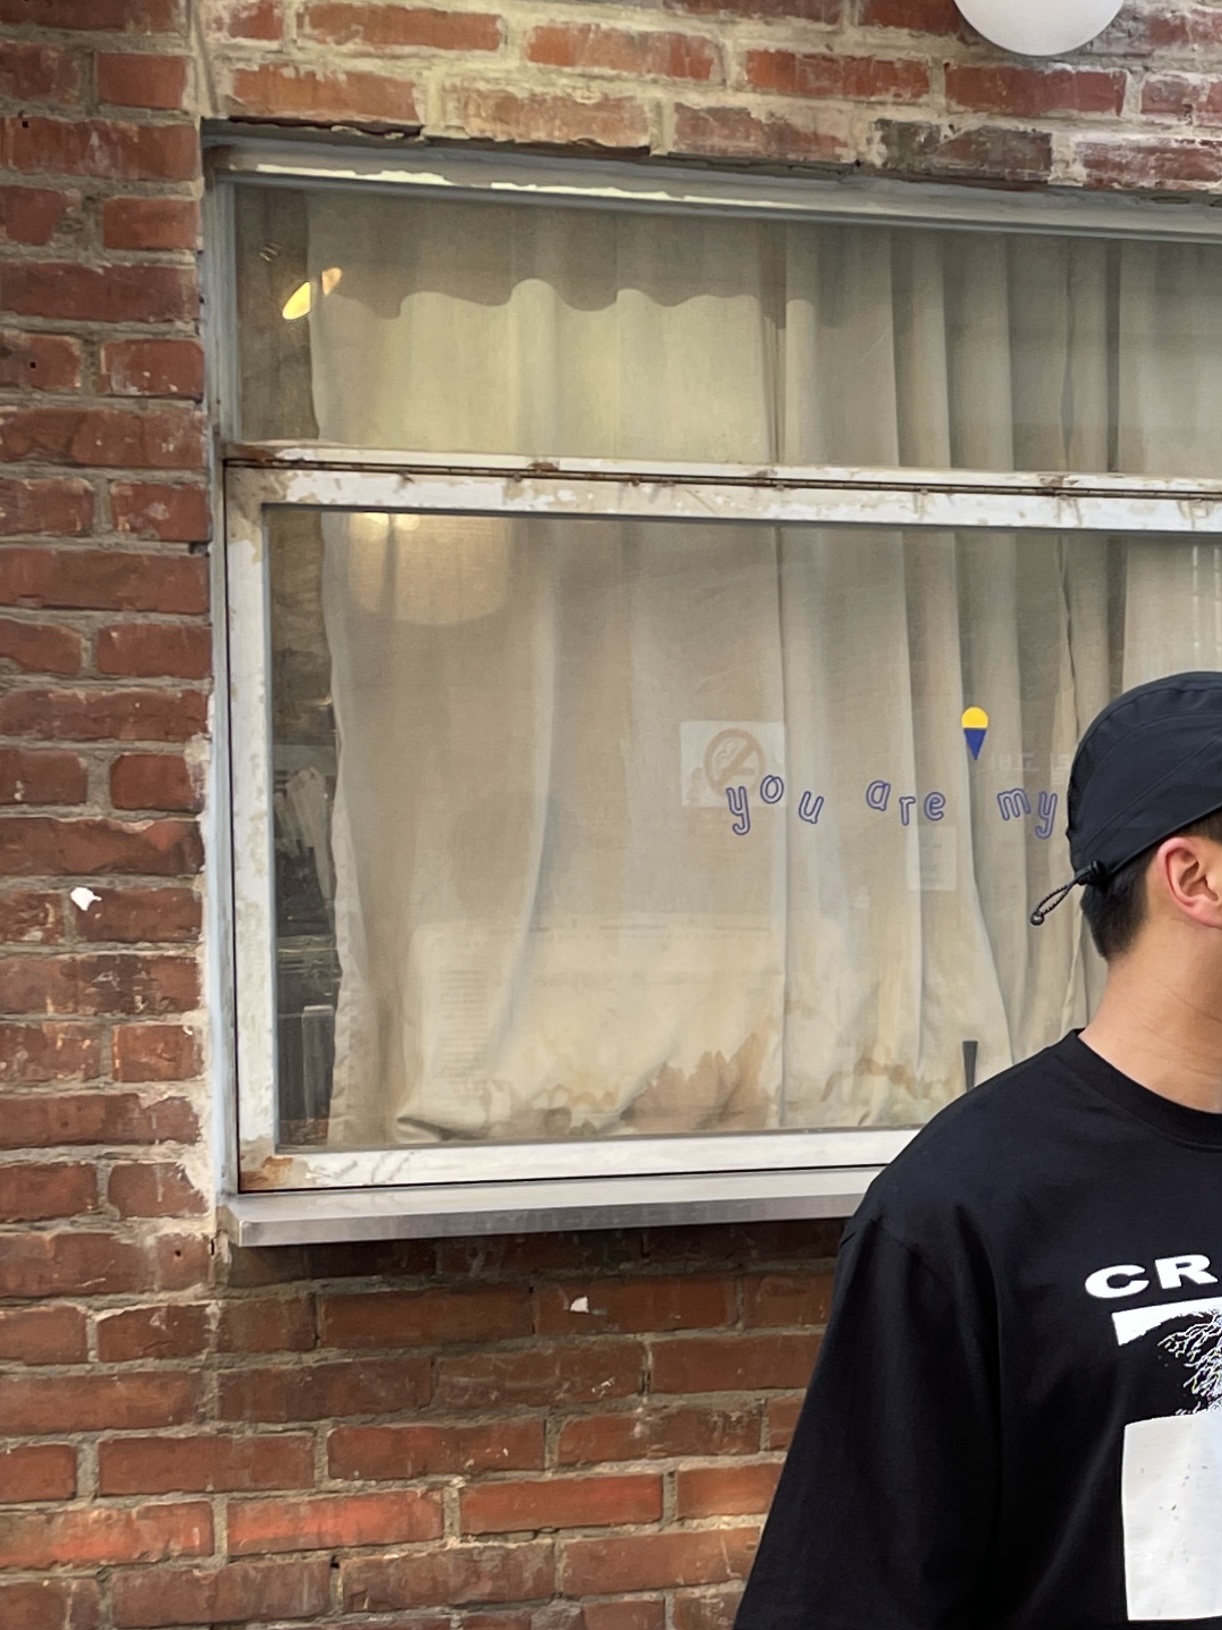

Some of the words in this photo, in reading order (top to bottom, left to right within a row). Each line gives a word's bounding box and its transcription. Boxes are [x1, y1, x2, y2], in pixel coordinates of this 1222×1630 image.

[726, 775, 824, 836] you
[866, 780, 946, 826] are
[997, 788, 1058, 840] my
